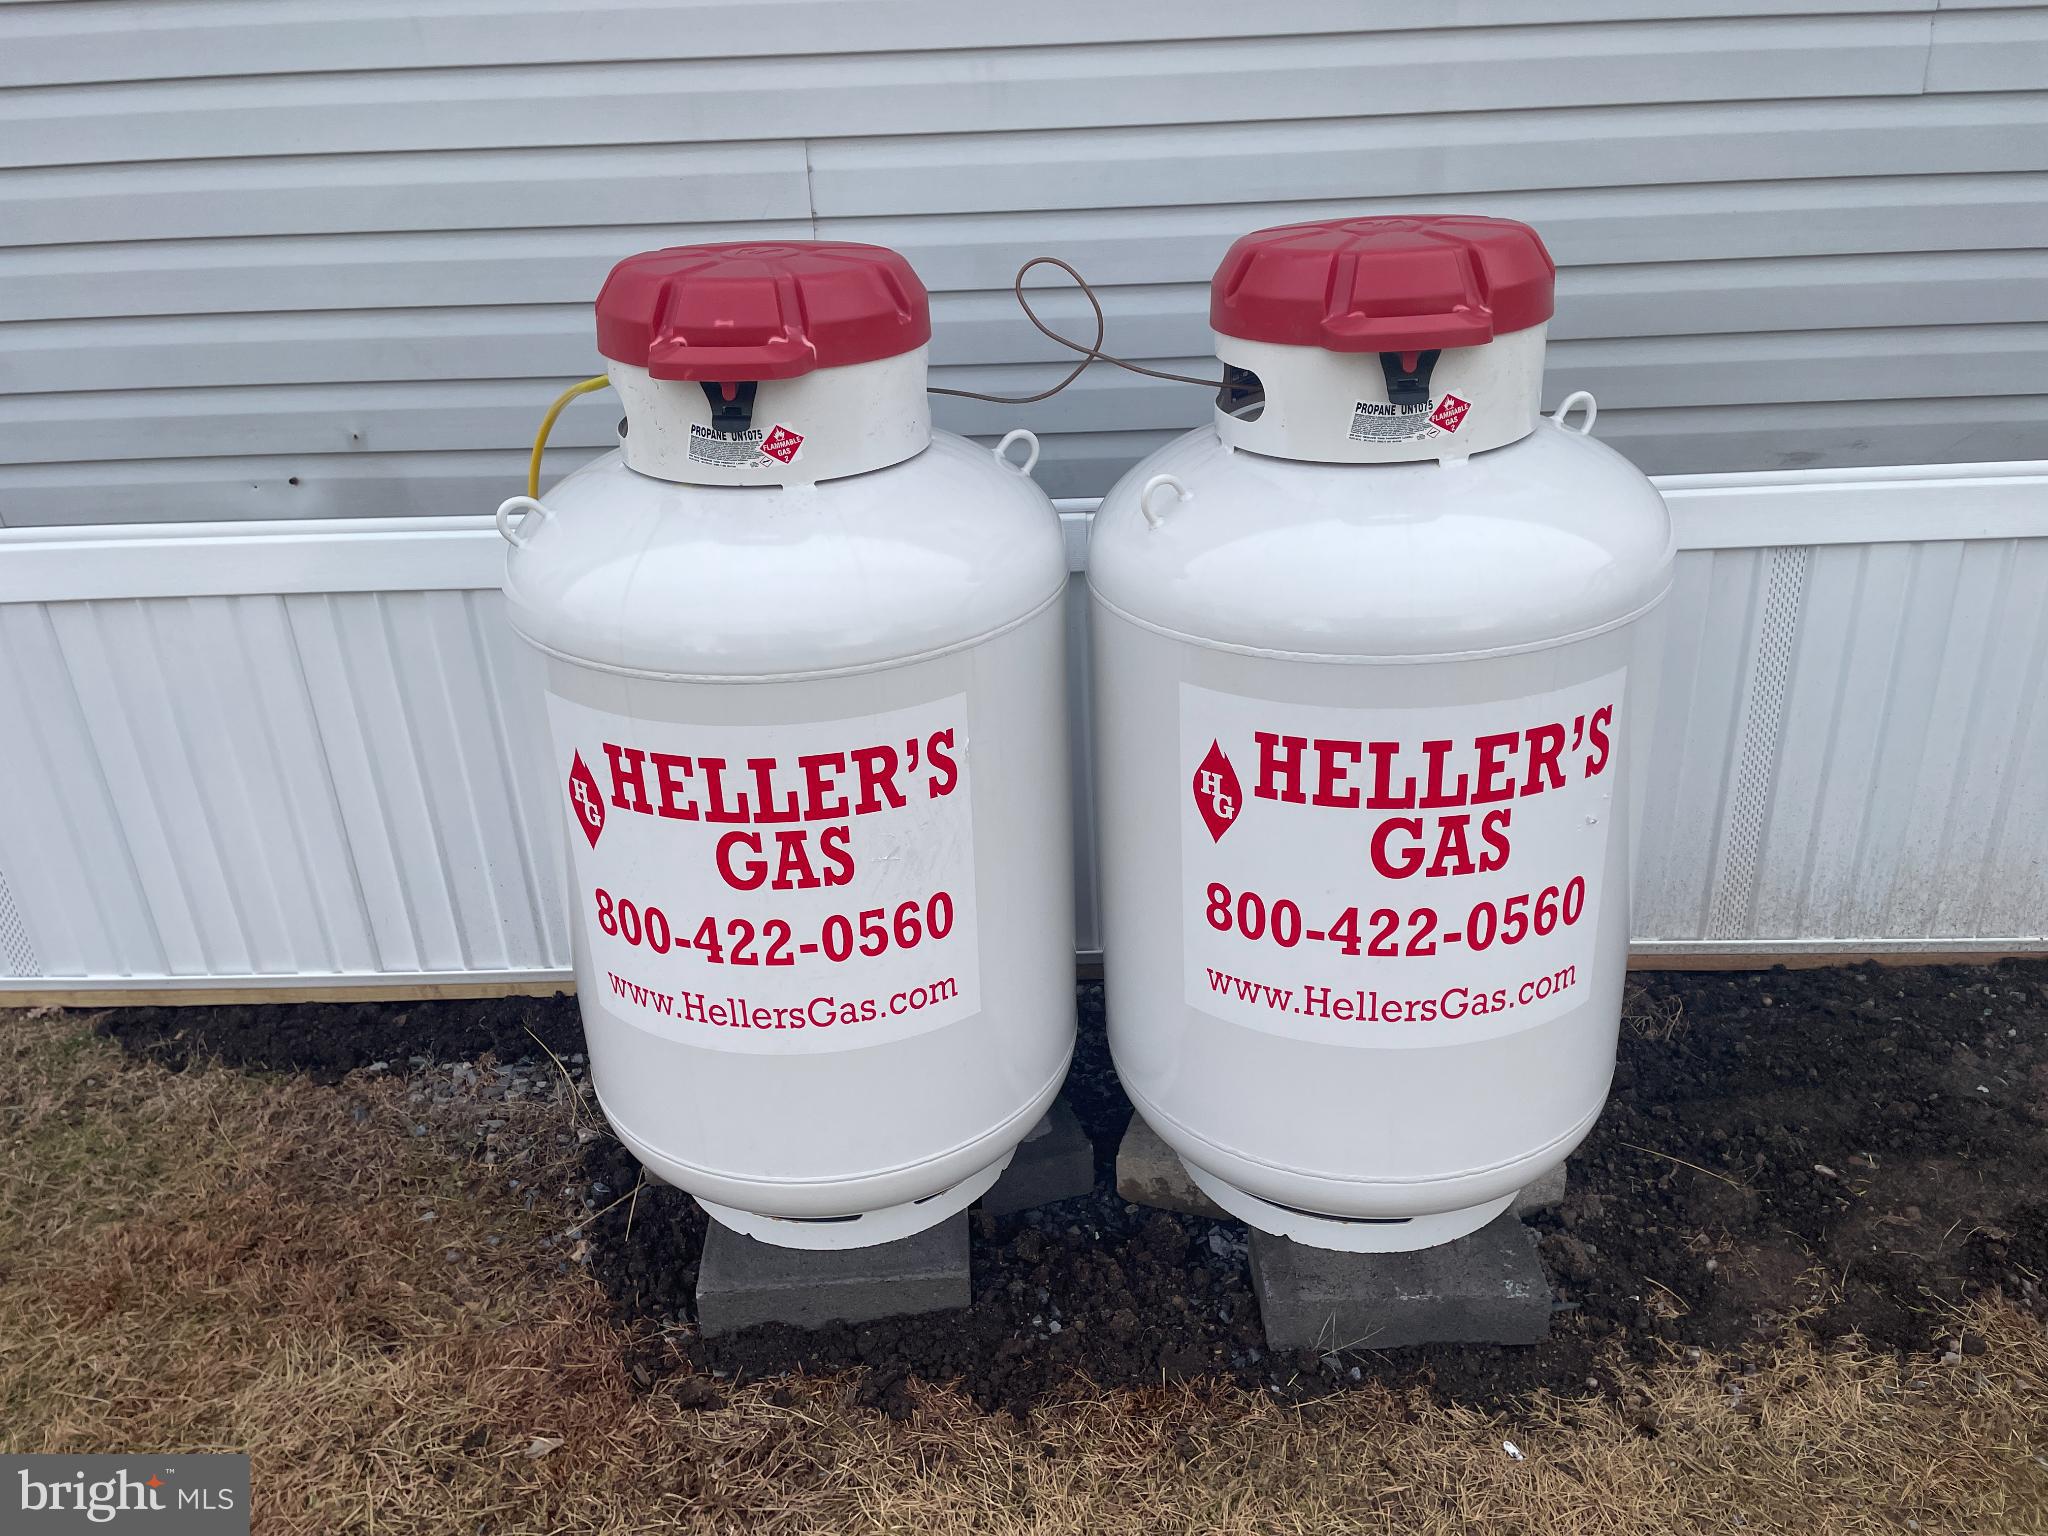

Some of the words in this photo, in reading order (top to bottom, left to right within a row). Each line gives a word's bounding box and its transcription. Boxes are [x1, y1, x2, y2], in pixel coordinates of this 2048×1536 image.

[691, 424, 727, 440] PROPANE
[731, 430, 763, 441] UN1075
[1355, 401, 1396, 416] PROPANE
[1401, 400, 1434, 415] UN1075
[1431, 403, 1469, 422] FLAMMABLE
[1445, 415, 1459, 426] GAS
[763, 437, 801, 451] FLAMMABLE
[778, 448, 791, 456] GAS
[602, 727, 959, 824] HELLER'S
[1253, 703, 1614, 810] HELLER'S
[715, 825, 855, 891] GAS
[1370, 808, 1512, 879] GAS
[595, 887, 954, 966] 800-422-0560
[1205, 875, 1586, 957] 800-422-0560
[608, 971, 958, 1029] www.HellersGas.com
[1206, 963, 1577, 1023] www.HellersGas.com
